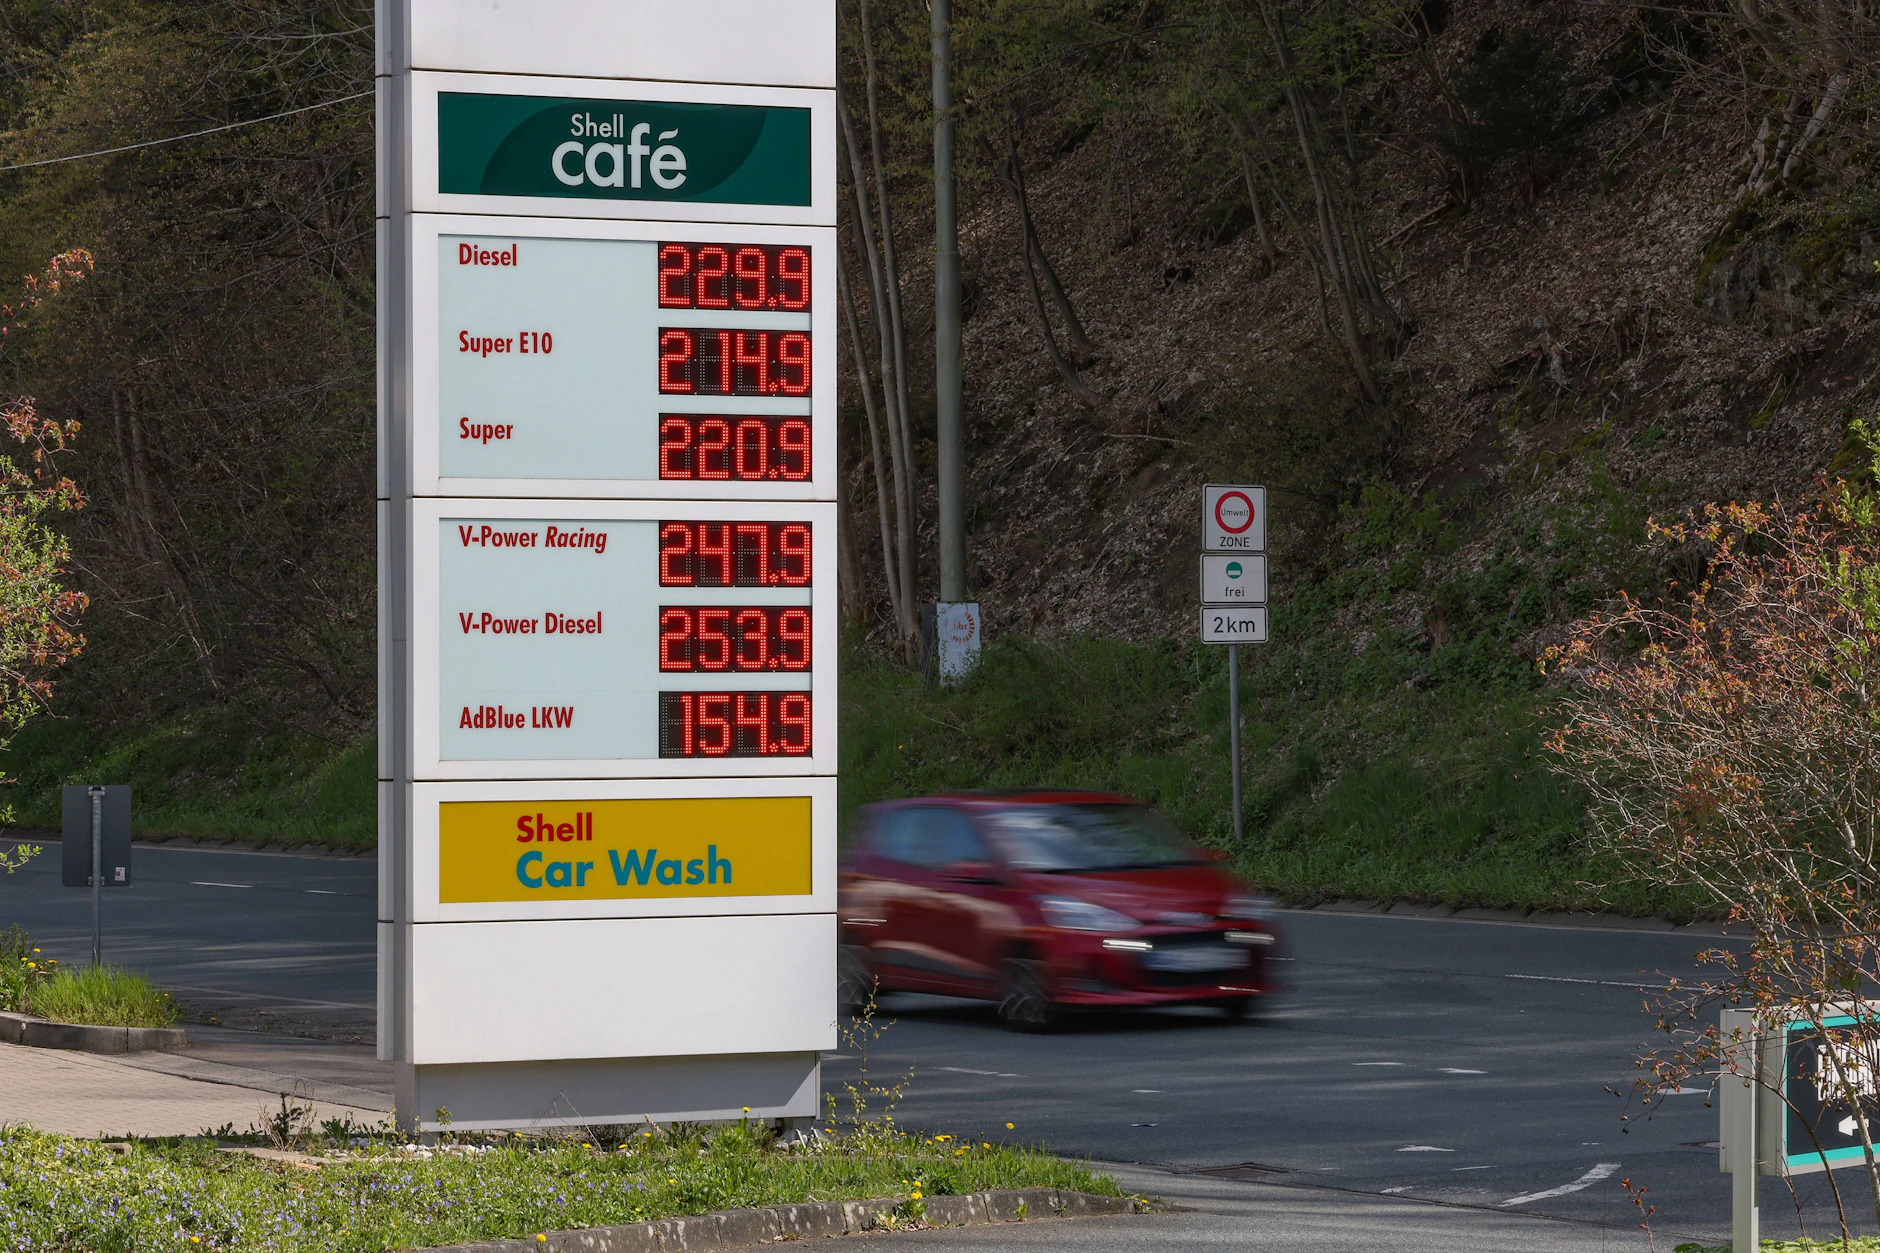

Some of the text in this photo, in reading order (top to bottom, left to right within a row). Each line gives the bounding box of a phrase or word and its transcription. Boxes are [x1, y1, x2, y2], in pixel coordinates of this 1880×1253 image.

[571, 113, 623, 137] Shell
[551, 122, 687, 190] café
[460, 244, 517, 266] Diesel
[660, 245, 809, 308] 229.9
[460, 330, 552, 358] Super E10
[660, 331, 810, 393] 214.9
[460, 417, 512, 444] Super
[660, 419, 810, 479] 220.9
[1220, 508, 1249, 517] Umwelt
[459, 526, 607, 554] V-Power Racing
[1219, 536, 1250, 548] ZONE
[660, 524, 810, 585] 247.9
[1225, 586, 1245, 597] frei
[460, 612, 601, 634] V-Power Diesel
[660, 610, 810, 669] 253.9
[460, 705, 573, 728] AdBlue LKW
[681, 694, 810, 754] 154.9
[517, 812, 592, 843] Shell
[517, 844, 732, 888] Car Wash
